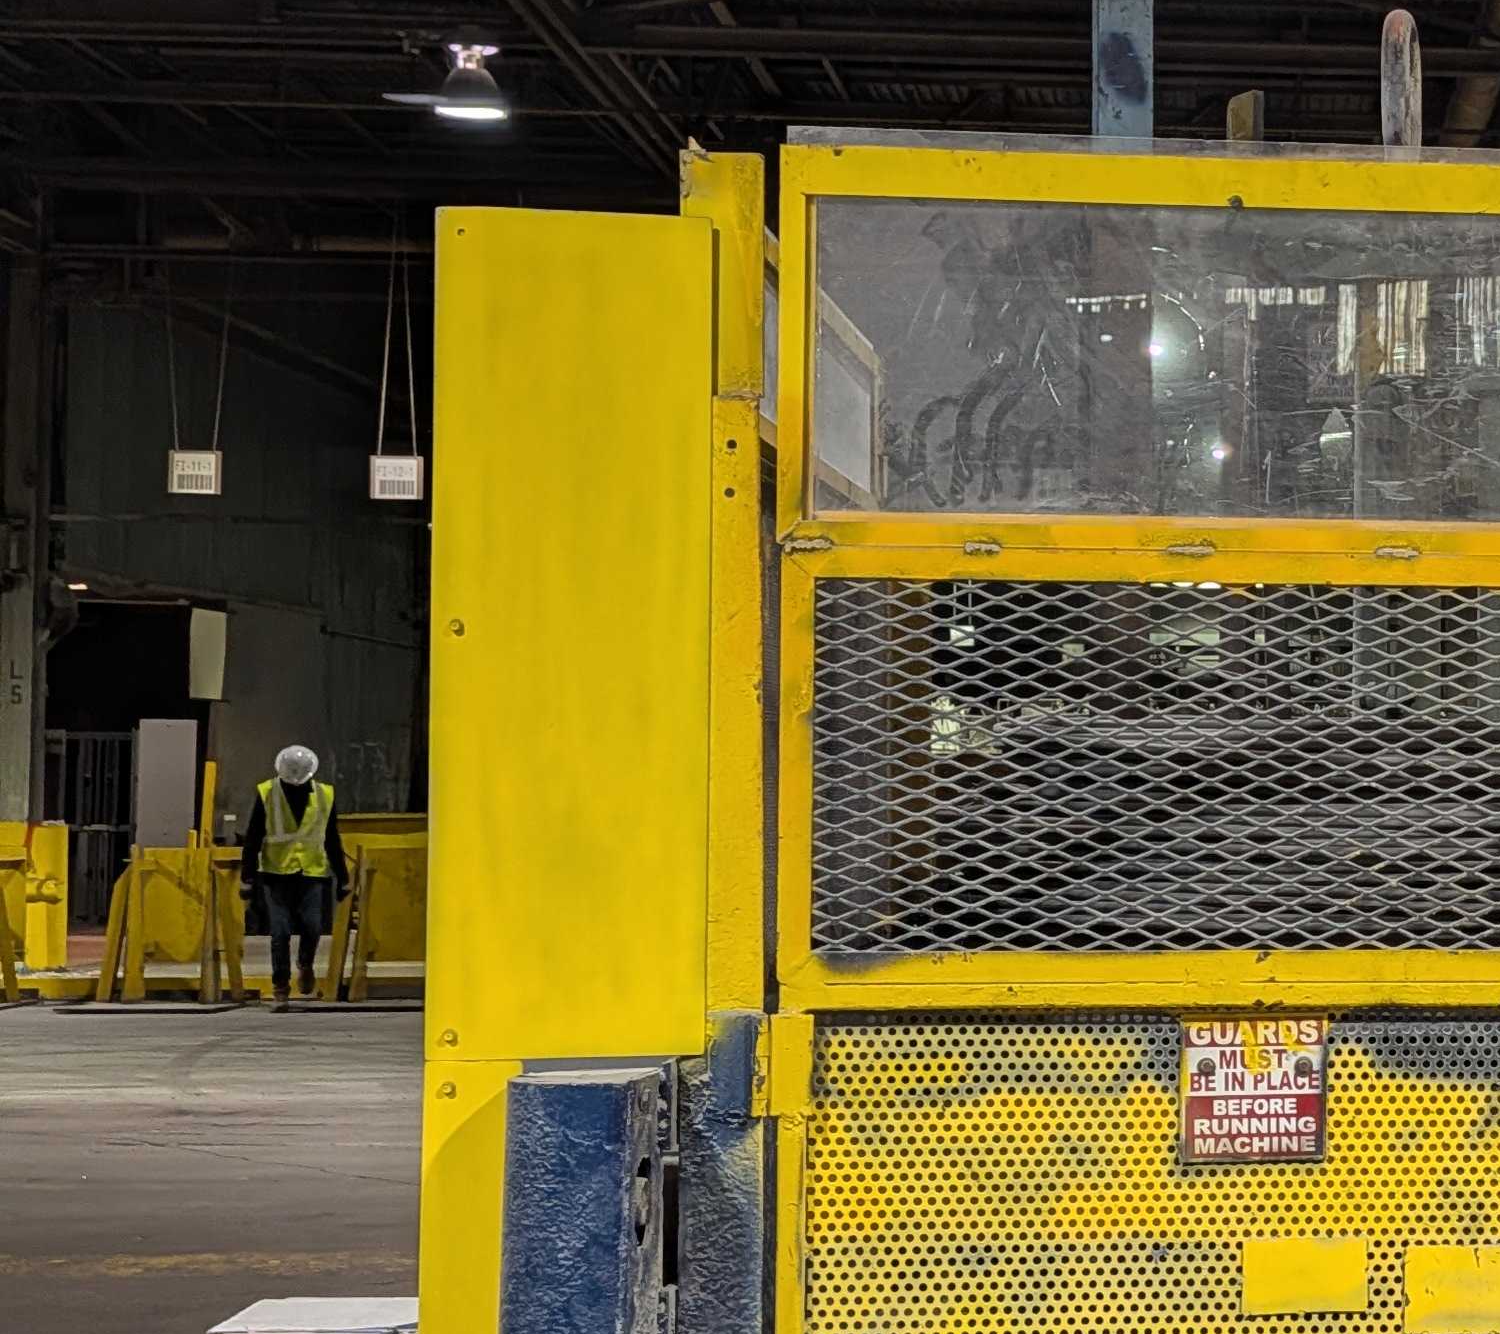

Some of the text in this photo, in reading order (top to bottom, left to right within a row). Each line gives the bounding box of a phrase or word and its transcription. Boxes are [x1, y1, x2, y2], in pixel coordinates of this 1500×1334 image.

[1188, 1020, 1319, 1045] GUARDS
[1219, 1049, 1288, 1069] MUST
[1190, 1069, 1320, 1092] BE IN PLACE
[1212, 1098, 1297, 1116] BEFORE
[1193, 1116, 1317, 1135] RUNNING
[1194, 1136, 1317, 1154] MACHINE
